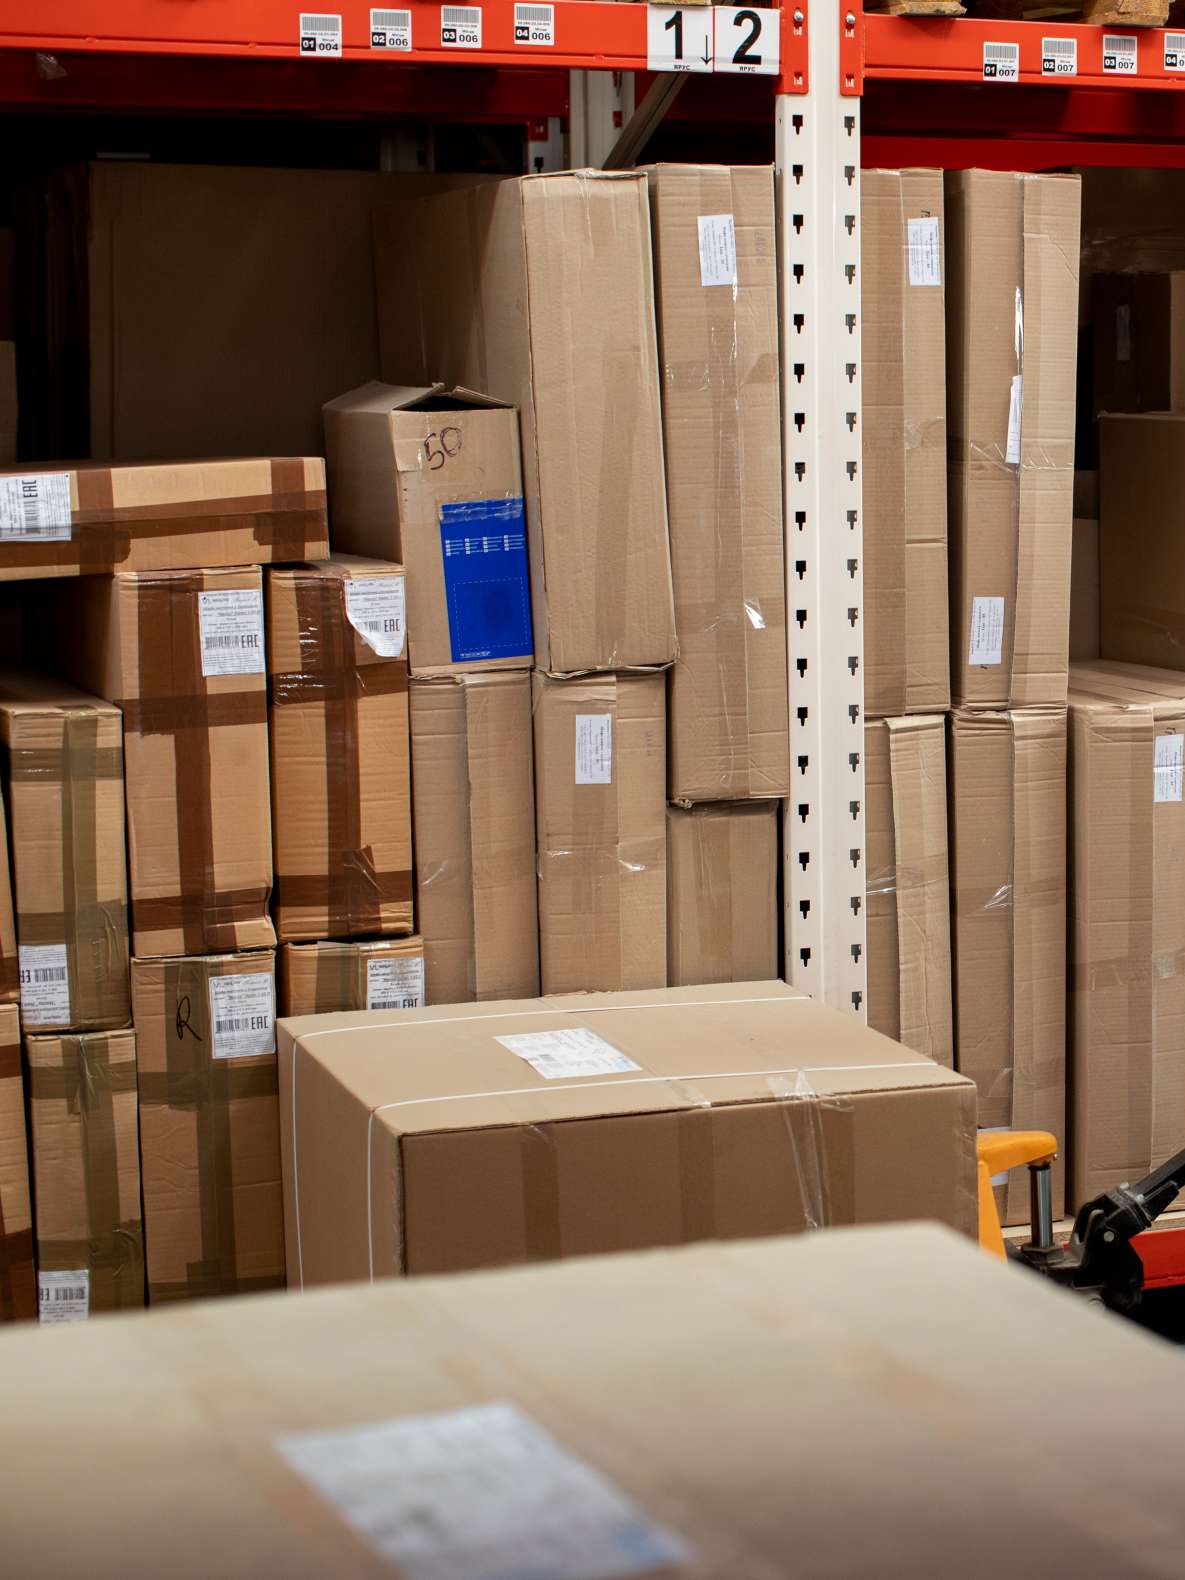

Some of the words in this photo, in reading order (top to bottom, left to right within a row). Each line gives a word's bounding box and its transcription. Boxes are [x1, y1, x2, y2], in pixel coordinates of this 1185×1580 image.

[373, 35, 385, 43] 02
[388, 38, 408, 47] 006
[443, 31, 455, 40] 03
[459, 34, 478, 43] 006
[517, 29, 529, 37] 04
[531, 32, 551, 41] 006
[665, 11, 683, 59] 1
[732, 10, 762, 64] 2
[303, 40, 314, 48] 01
[318, 43, 338, 51] 004
[985, 66, 995, 74] 01
[998, 69, 1016, 77] 007
[1043, 61, 1054, 70] 02
[1057, 63, 1074, 72] 007
[1118, 61, 1134, 69] 007
[423, 426, 463, 471] 50
[21, 479, 38, 498] EAC
[384, 618, 401, 633] EAC
[241, 634, 260, 648] EAC
[176, 995, 203, 1042] R
[251, 1016, 269, 1030] EAC
